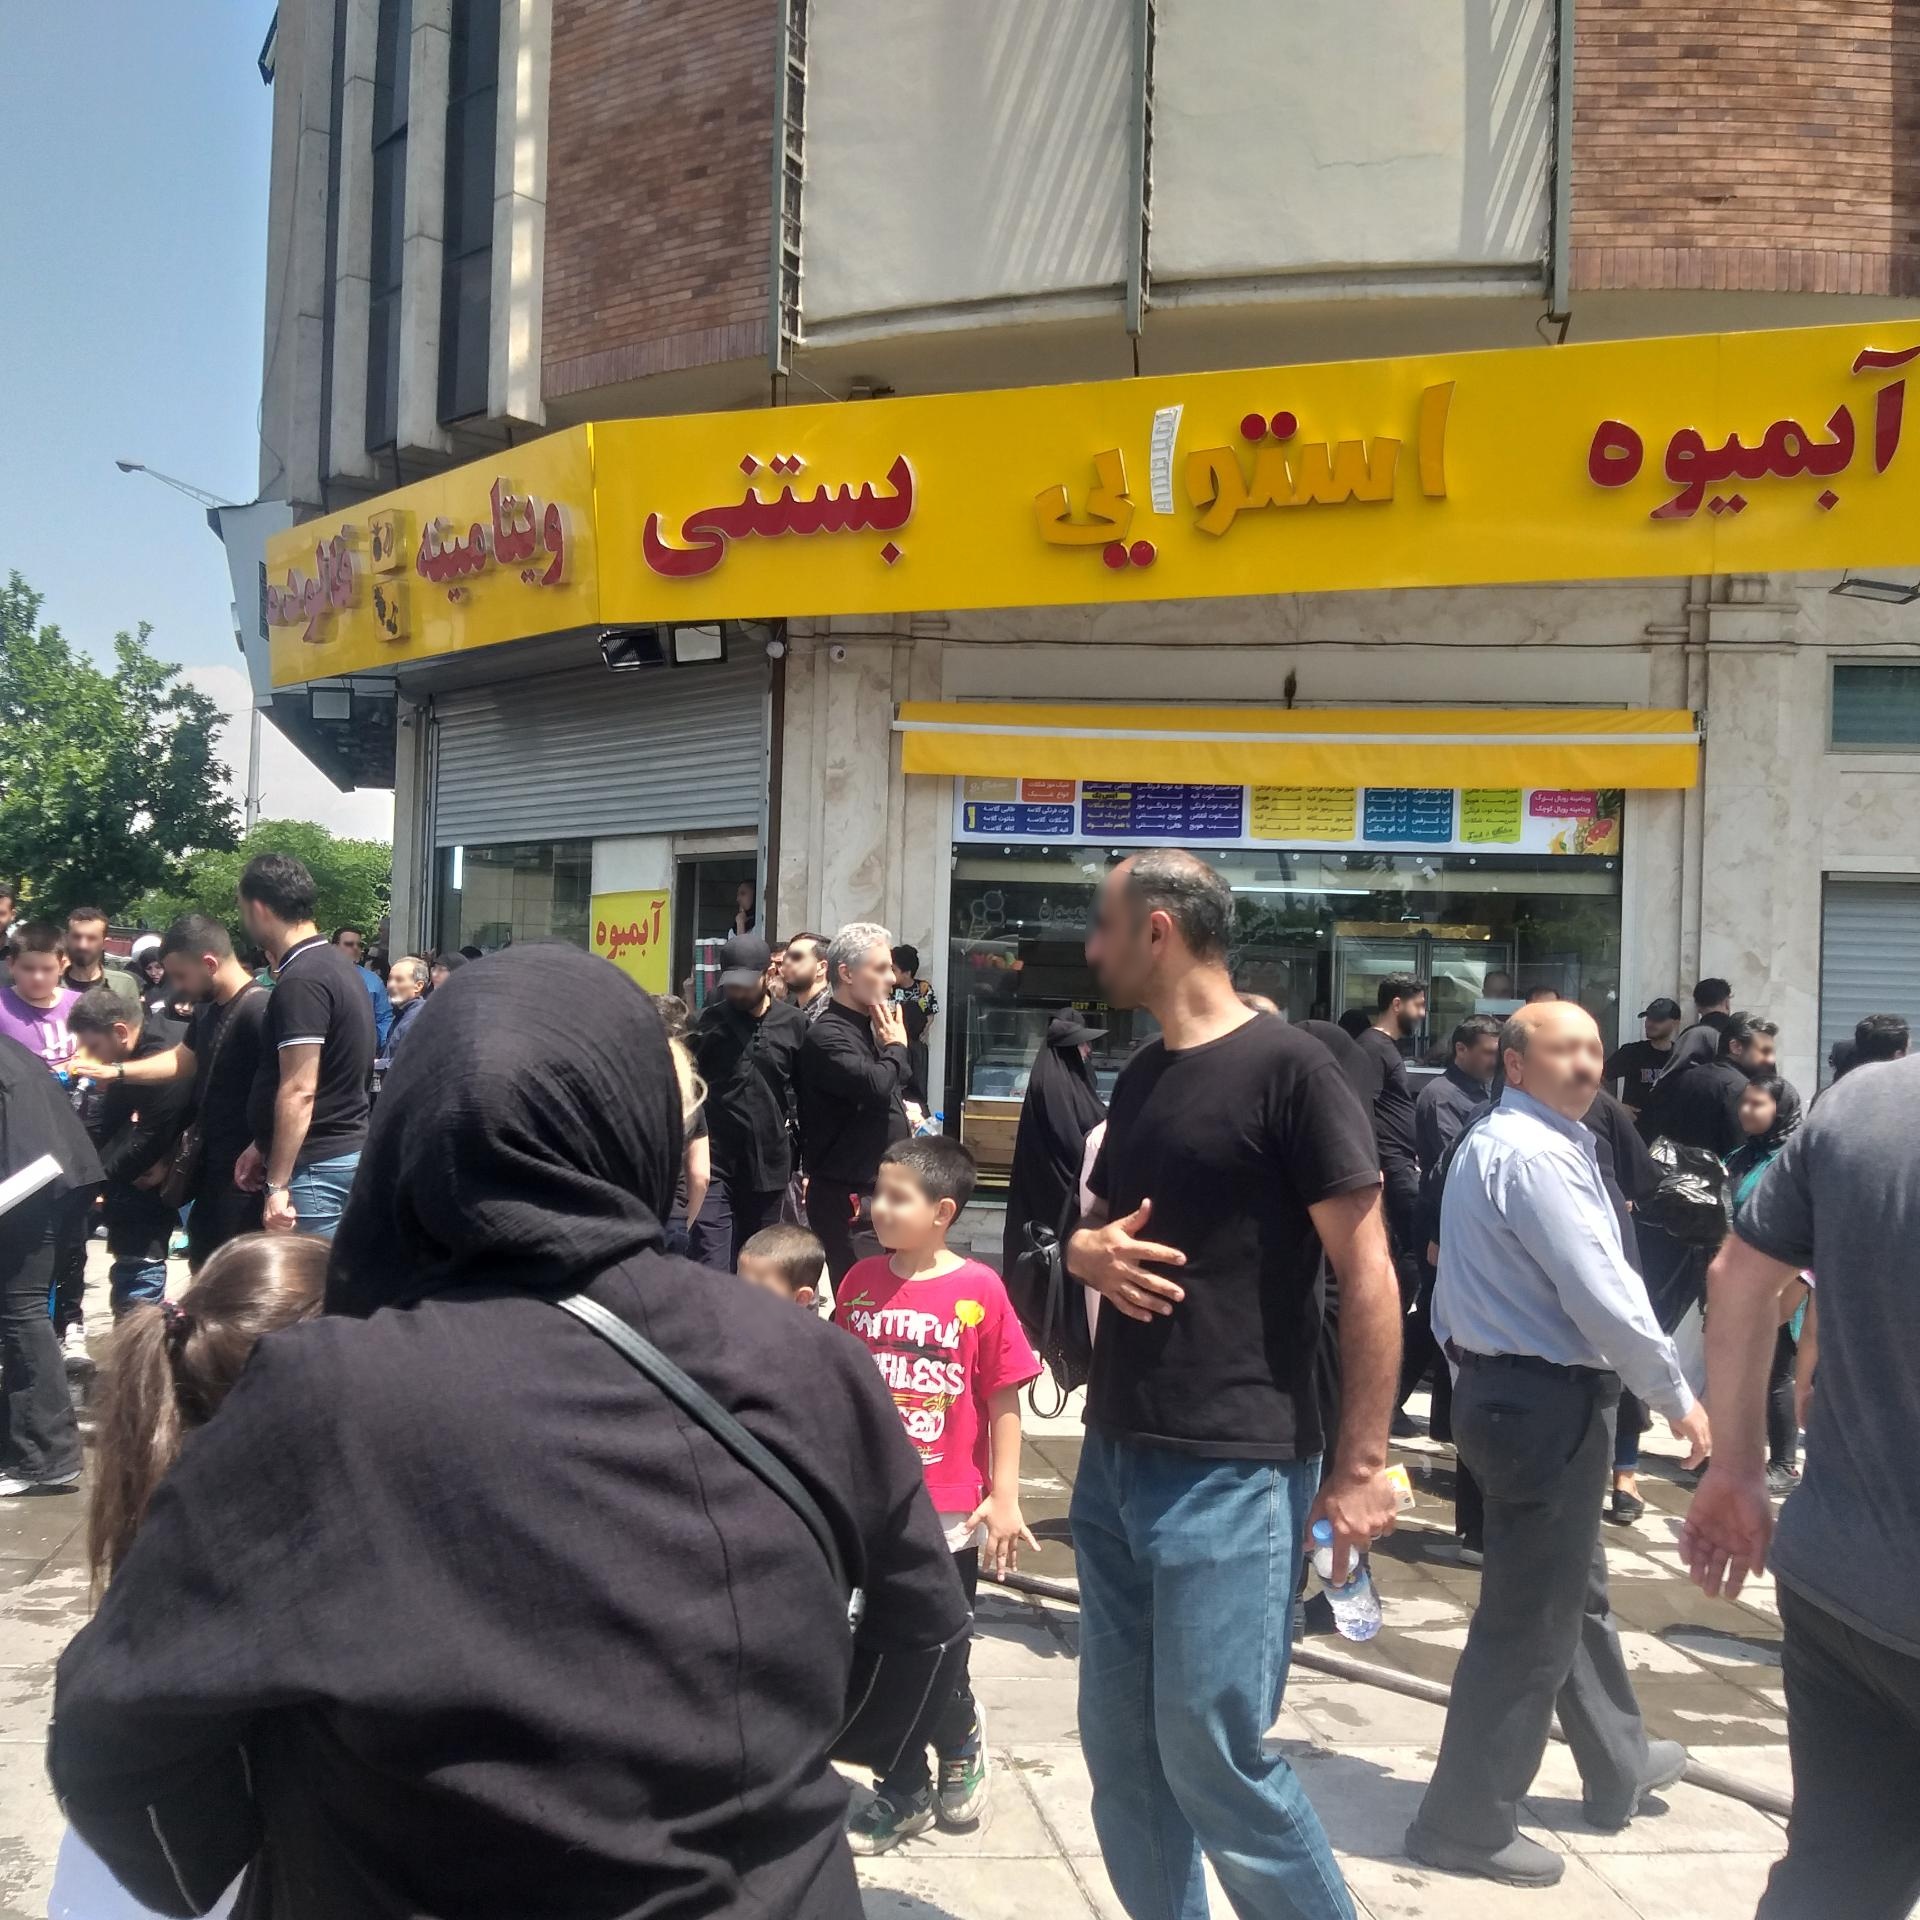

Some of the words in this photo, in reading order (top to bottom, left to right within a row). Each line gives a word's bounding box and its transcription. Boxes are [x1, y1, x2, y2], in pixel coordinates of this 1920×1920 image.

[1587, 345, 1920, 520] آبمیوه
[416, 475, 568, 603] ویتامینه
[642, 453, 917, 578] بستنی
[595, 900, 666, 960] آبمیوه
